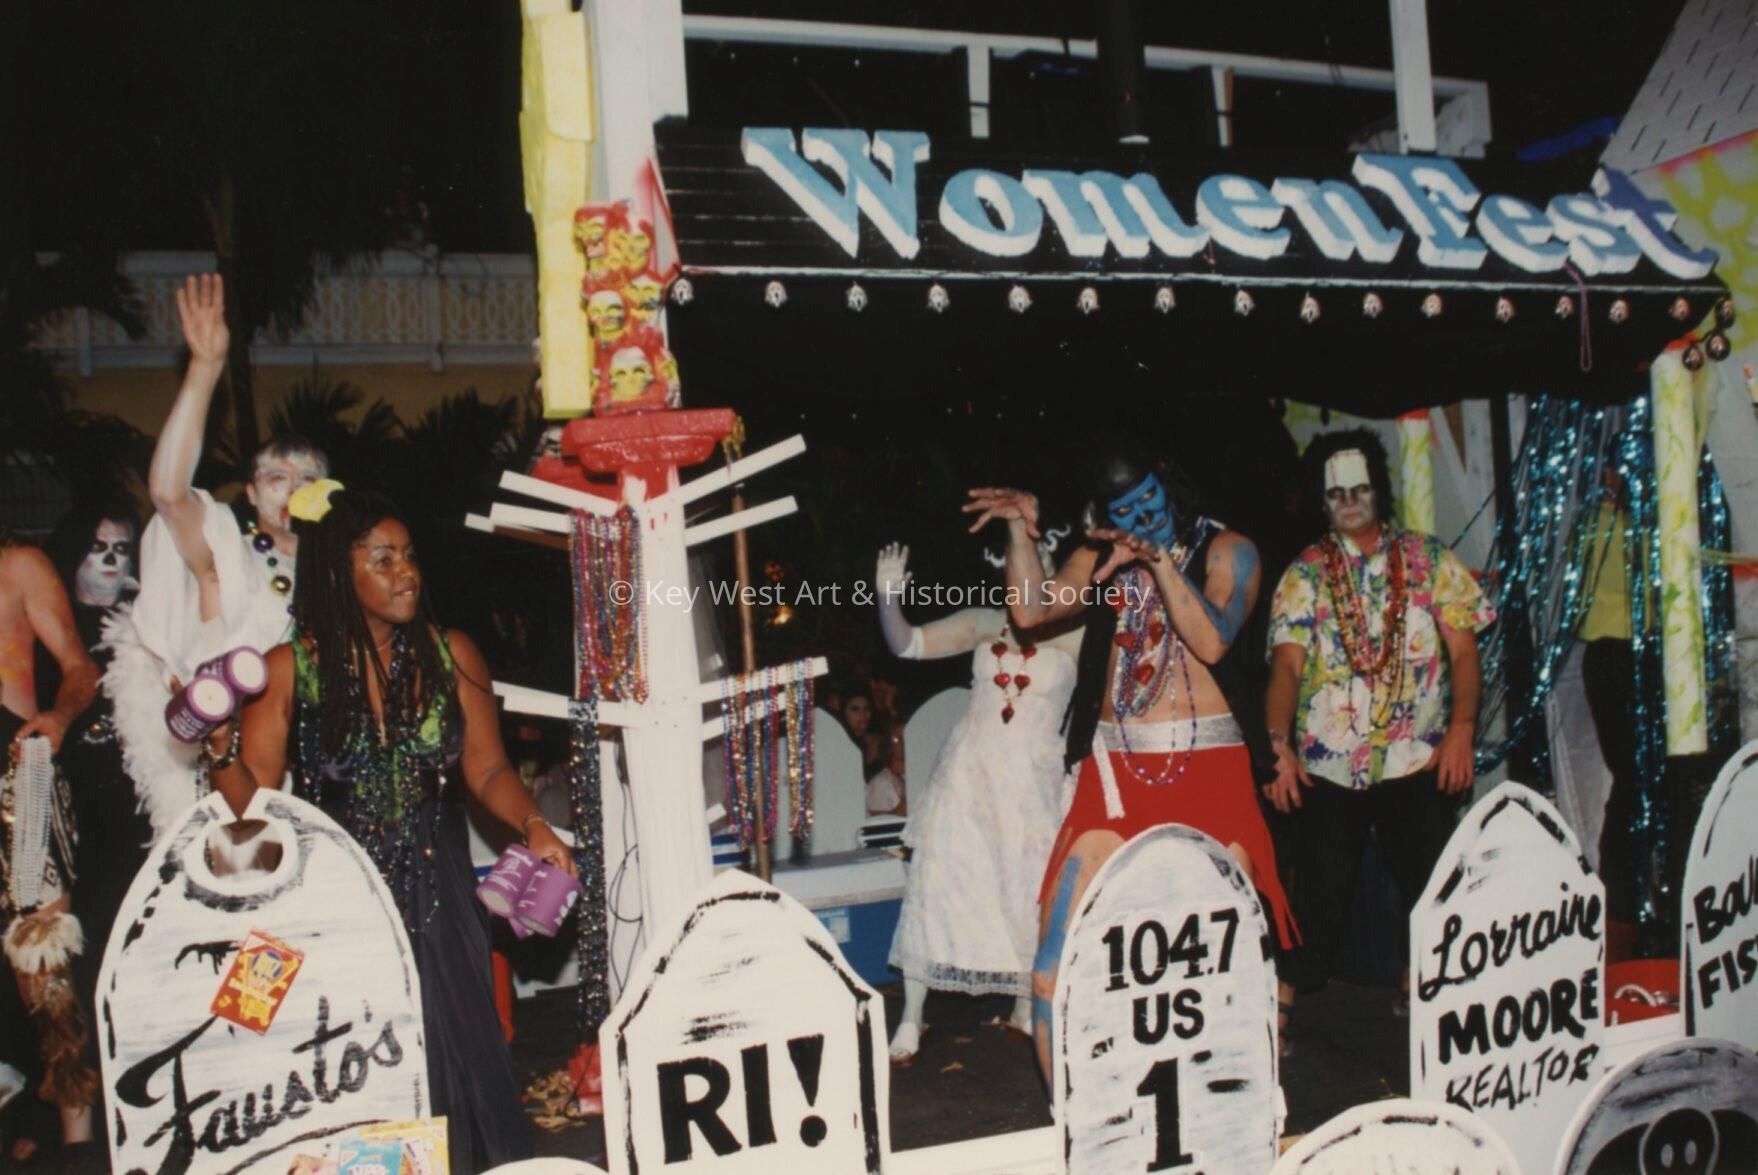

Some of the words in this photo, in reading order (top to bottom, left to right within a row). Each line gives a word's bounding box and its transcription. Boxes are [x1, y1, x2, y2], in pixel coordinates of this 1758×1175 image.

[741, 126, 1720, 280] WomenFest
[1101, 907, 1240, 993] 104.7
[1418, 881, 1602, 1002] Lorraine
[1697, 936, 1758, 1010] FIS
[1132, 988, 1205, 1046] US
[1438, 966, 1599, 1065] MOORE
[115, 994, 403, 1175] Fausto's
[656, 1032, 828, 1165] RI!
